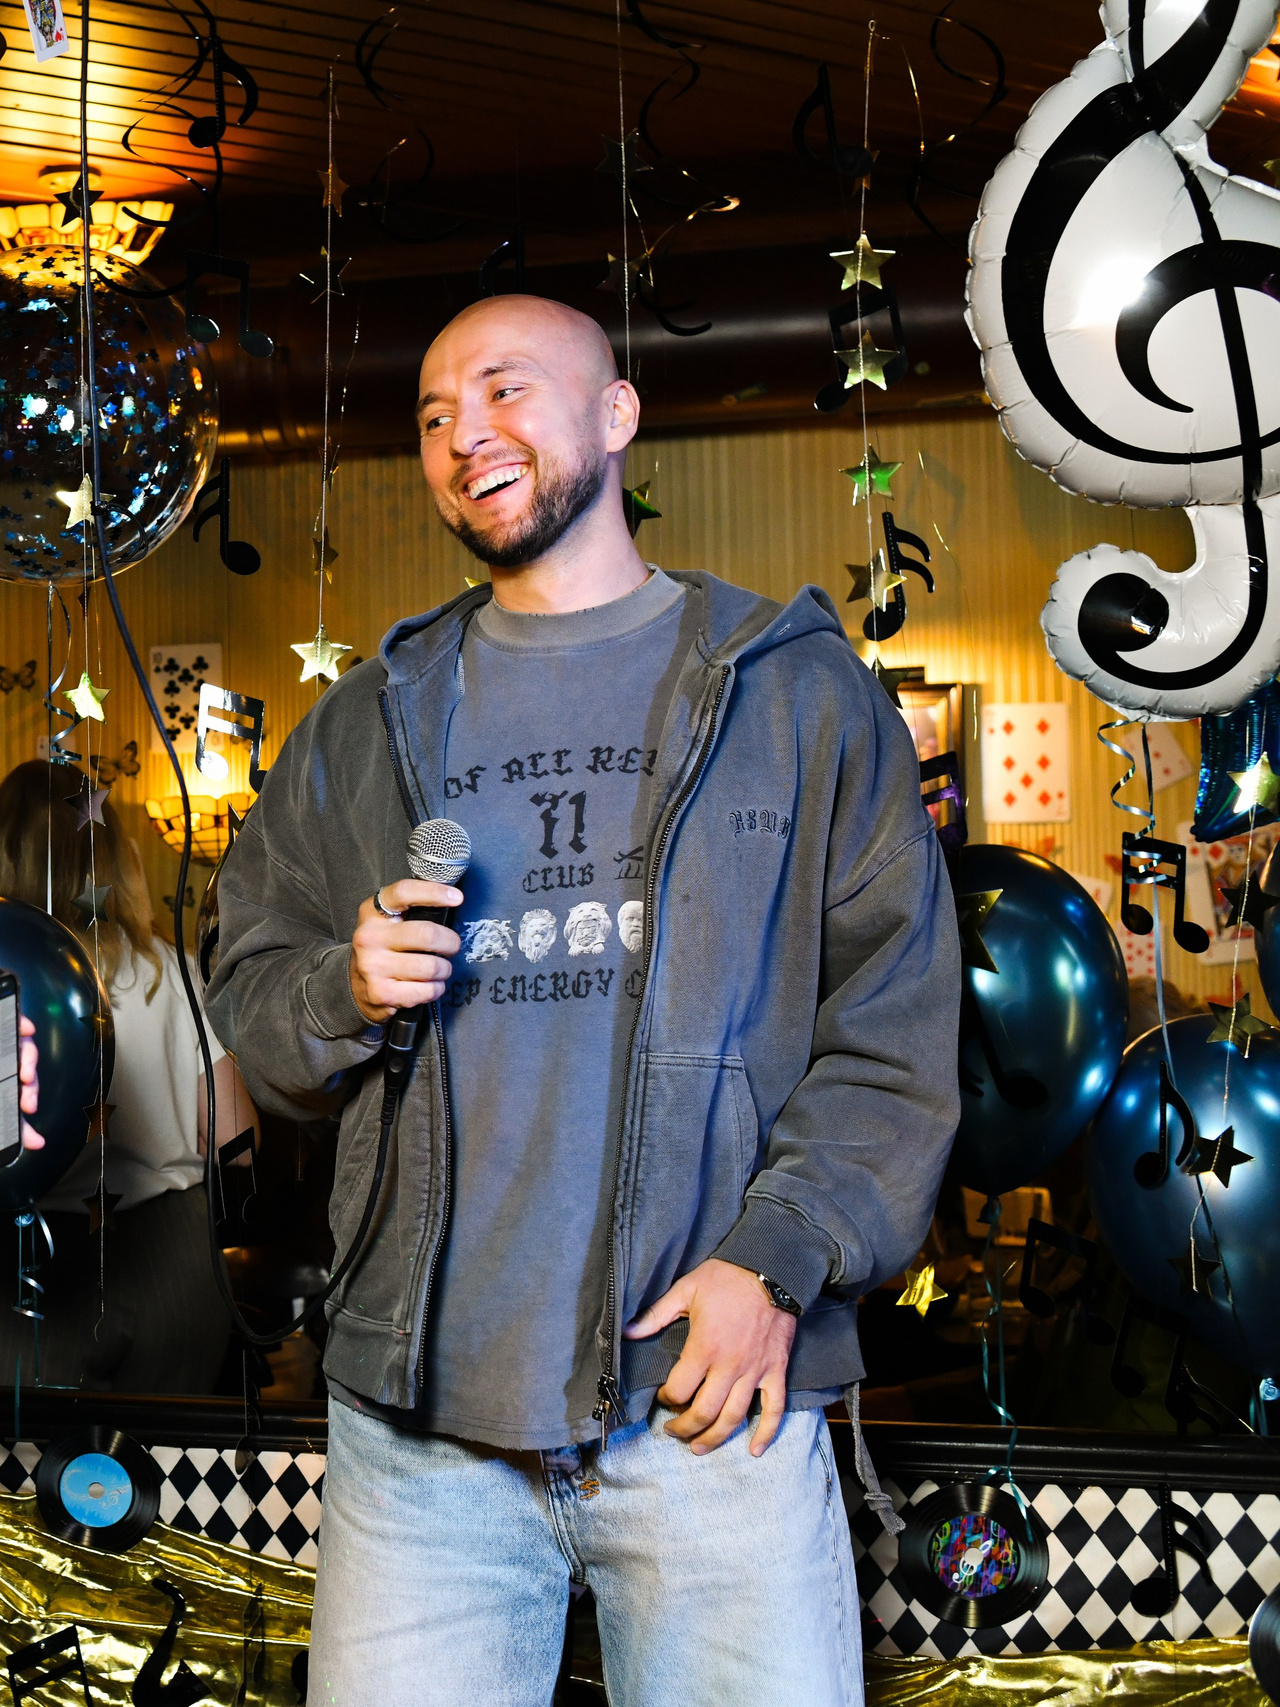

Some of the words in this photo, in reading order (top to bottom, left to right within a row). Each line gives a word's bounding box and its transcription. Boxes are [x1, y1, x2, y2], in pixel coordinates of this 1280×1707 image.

[444, 764, 487, 799] OF
[501, 748, 574, 784] ALL
[522, 861, 595, 893] CLUB
[489, 967, 616, 1004] ENERGY
